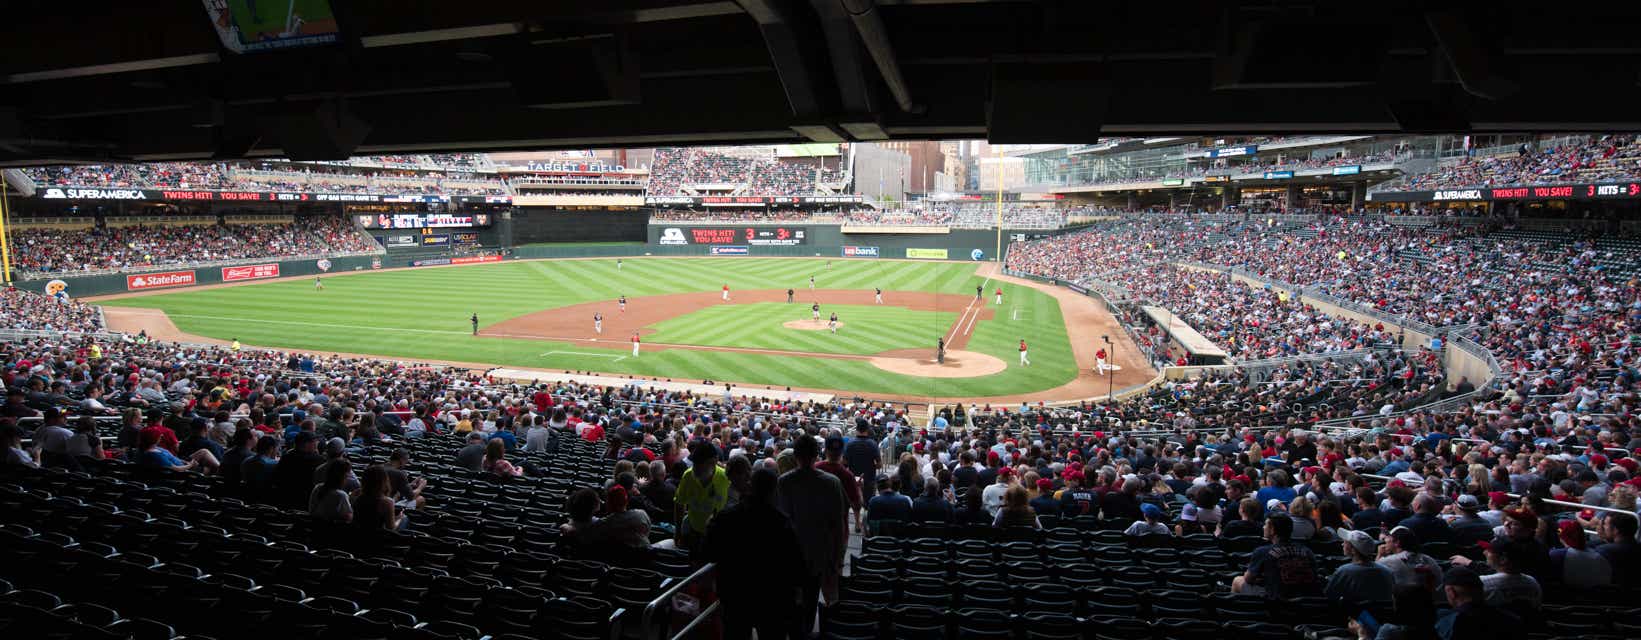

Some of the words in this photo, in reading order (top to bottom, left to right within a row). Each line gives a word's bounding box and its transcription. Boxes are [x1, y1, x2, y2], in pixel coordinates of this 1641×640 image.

[528, 163, 577, 171] TARGET
[589, 164, 625, 172] FIELD
[67, 189, 146, 199] SUPERAMERICA
[163, 191, 193, 199] TWINS
[194, 191, 213, 199] HIT!
[1443, 190, 1482, 200] SUPERAMERICA
[1493, 190, 1513, 198] TWINS
[1535, 188, 1550, 196] YOU
[1551, 187, 1573, 196] SAVE!
[1588, 186, 1595, 196] 3
[1598, 186, 1618, 195] HITS
[746, 228, 754, 240] 3
